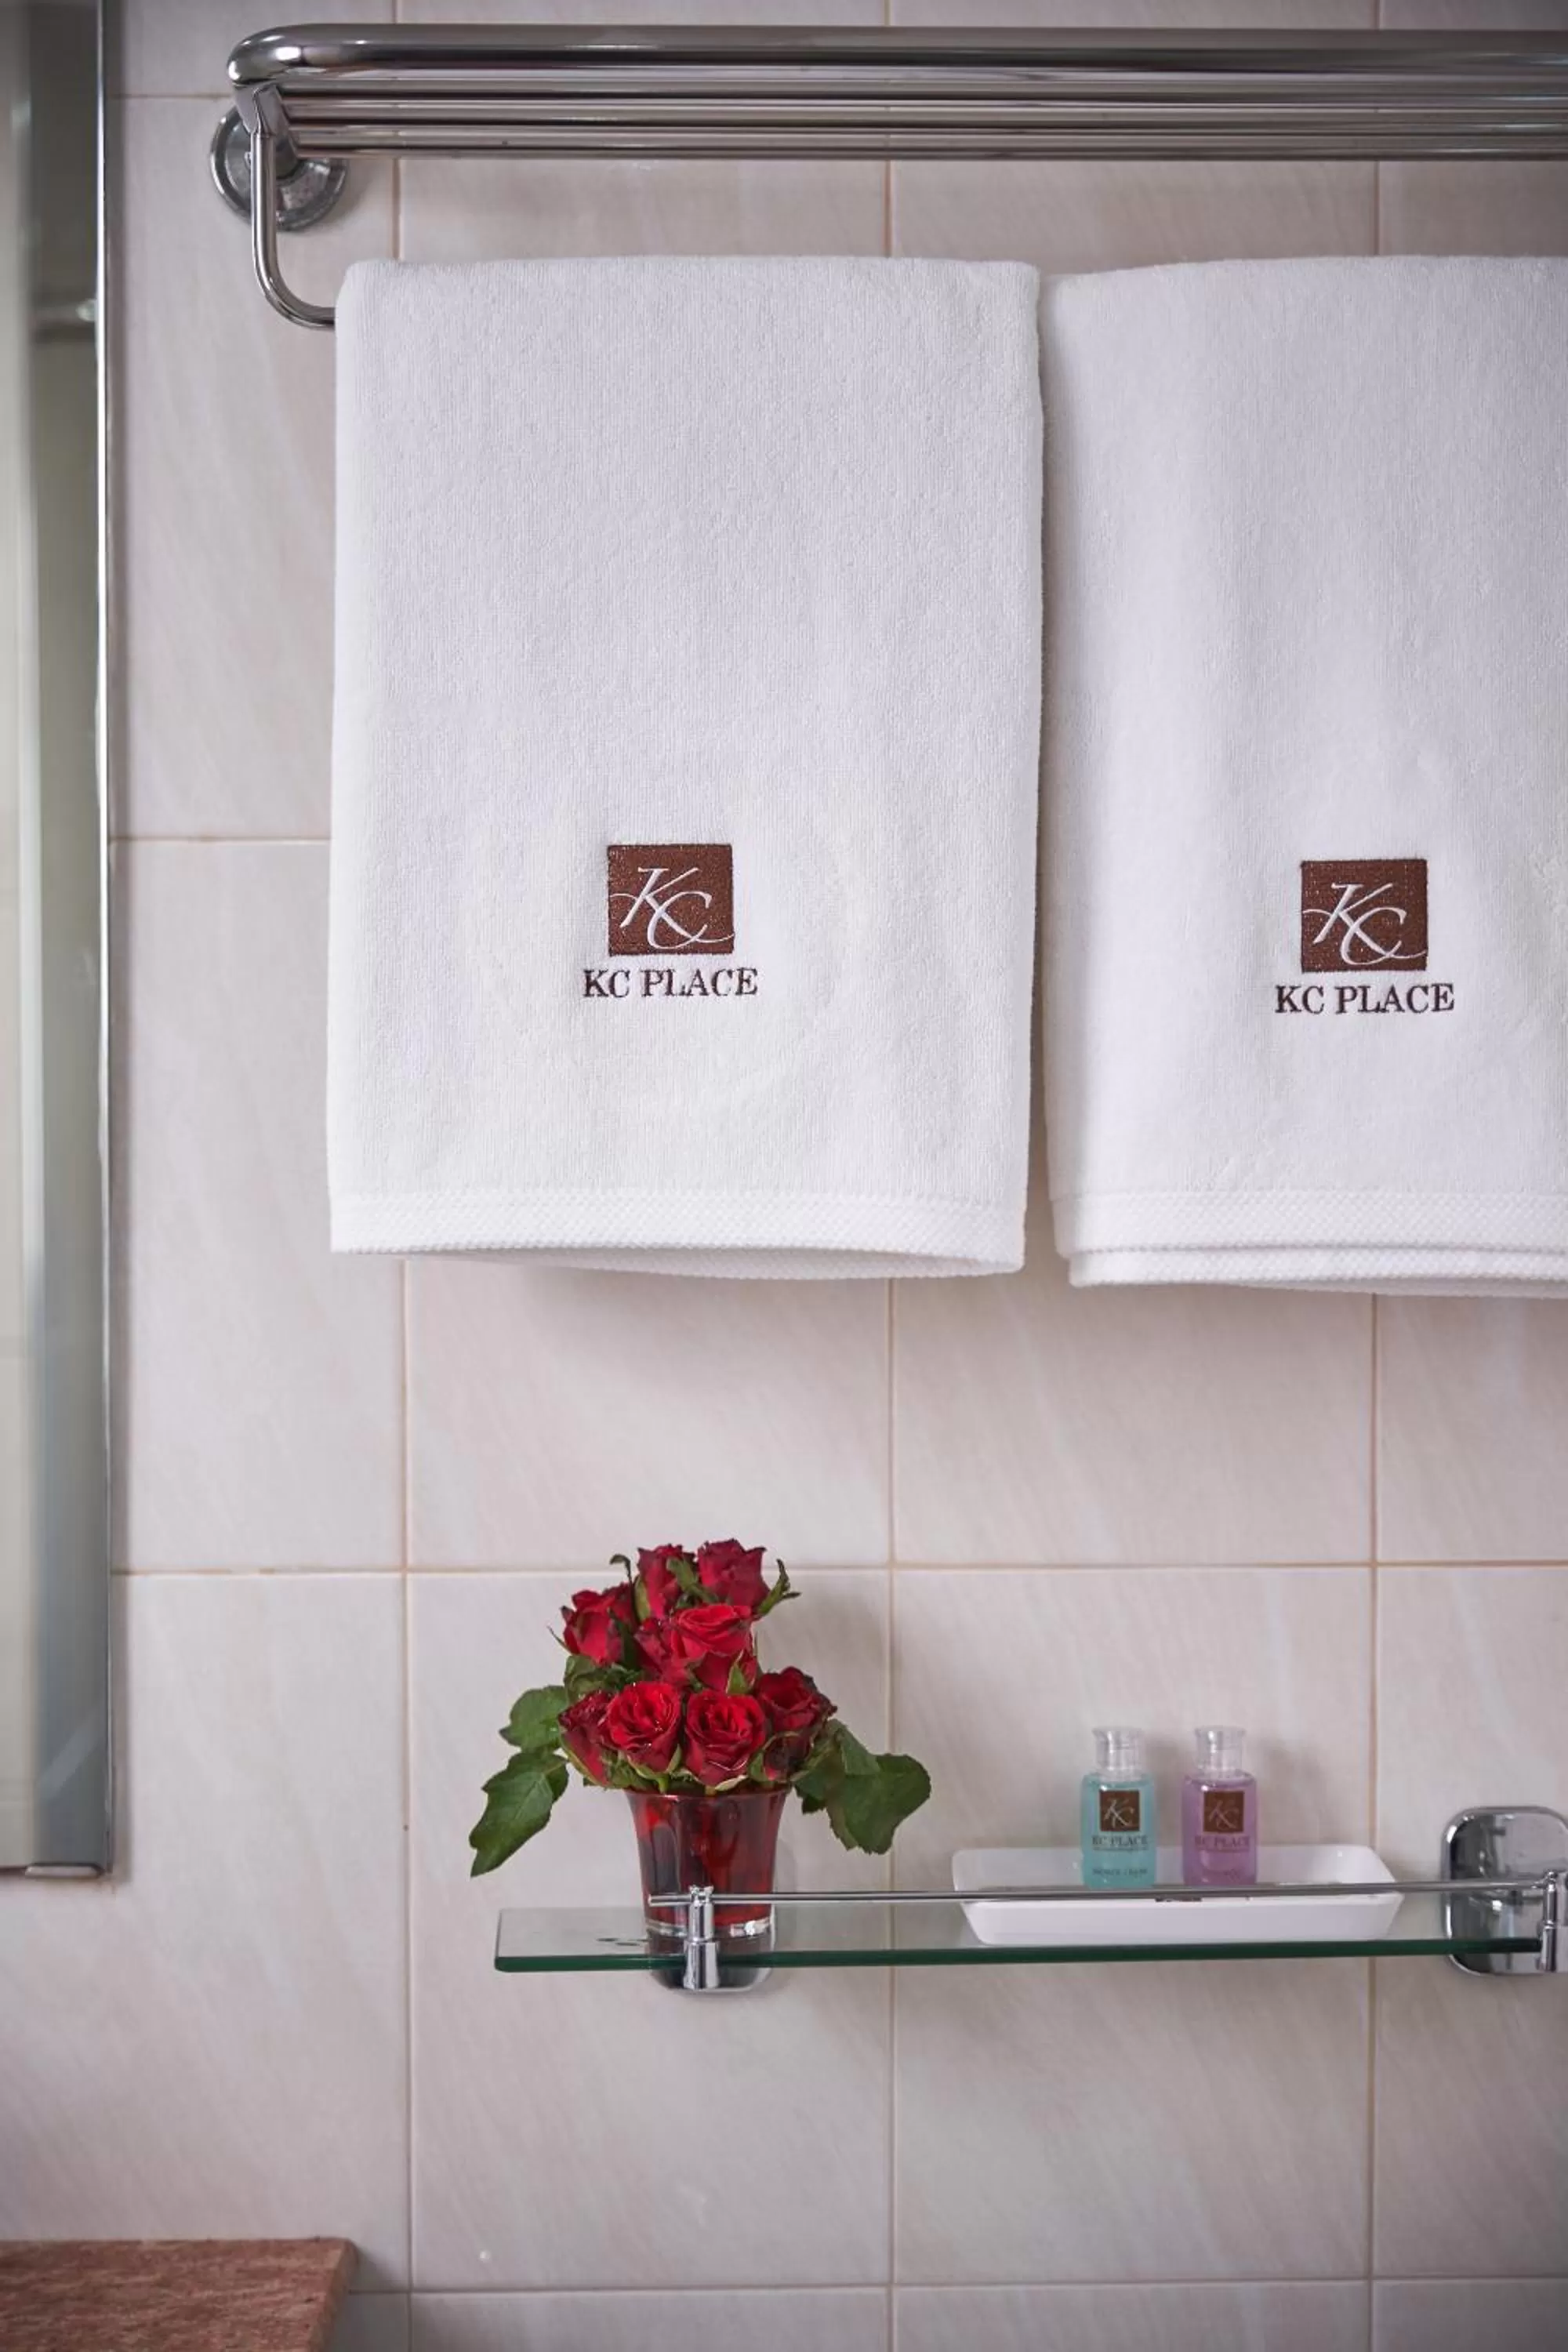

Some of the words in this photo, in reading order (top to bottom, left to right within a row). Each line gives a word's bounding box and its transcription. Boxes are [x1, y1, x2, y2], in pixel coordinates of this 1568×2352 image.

[608, 866, 735, 949] KC
[1302, 883, 1426, 965] KC
[583, 969, 630, 997] KC
[641, 967, 758, 997] PLACE
[1275, 985, 1325, 1014] KC
[1335, 983, 1454, 1014] PLACE
